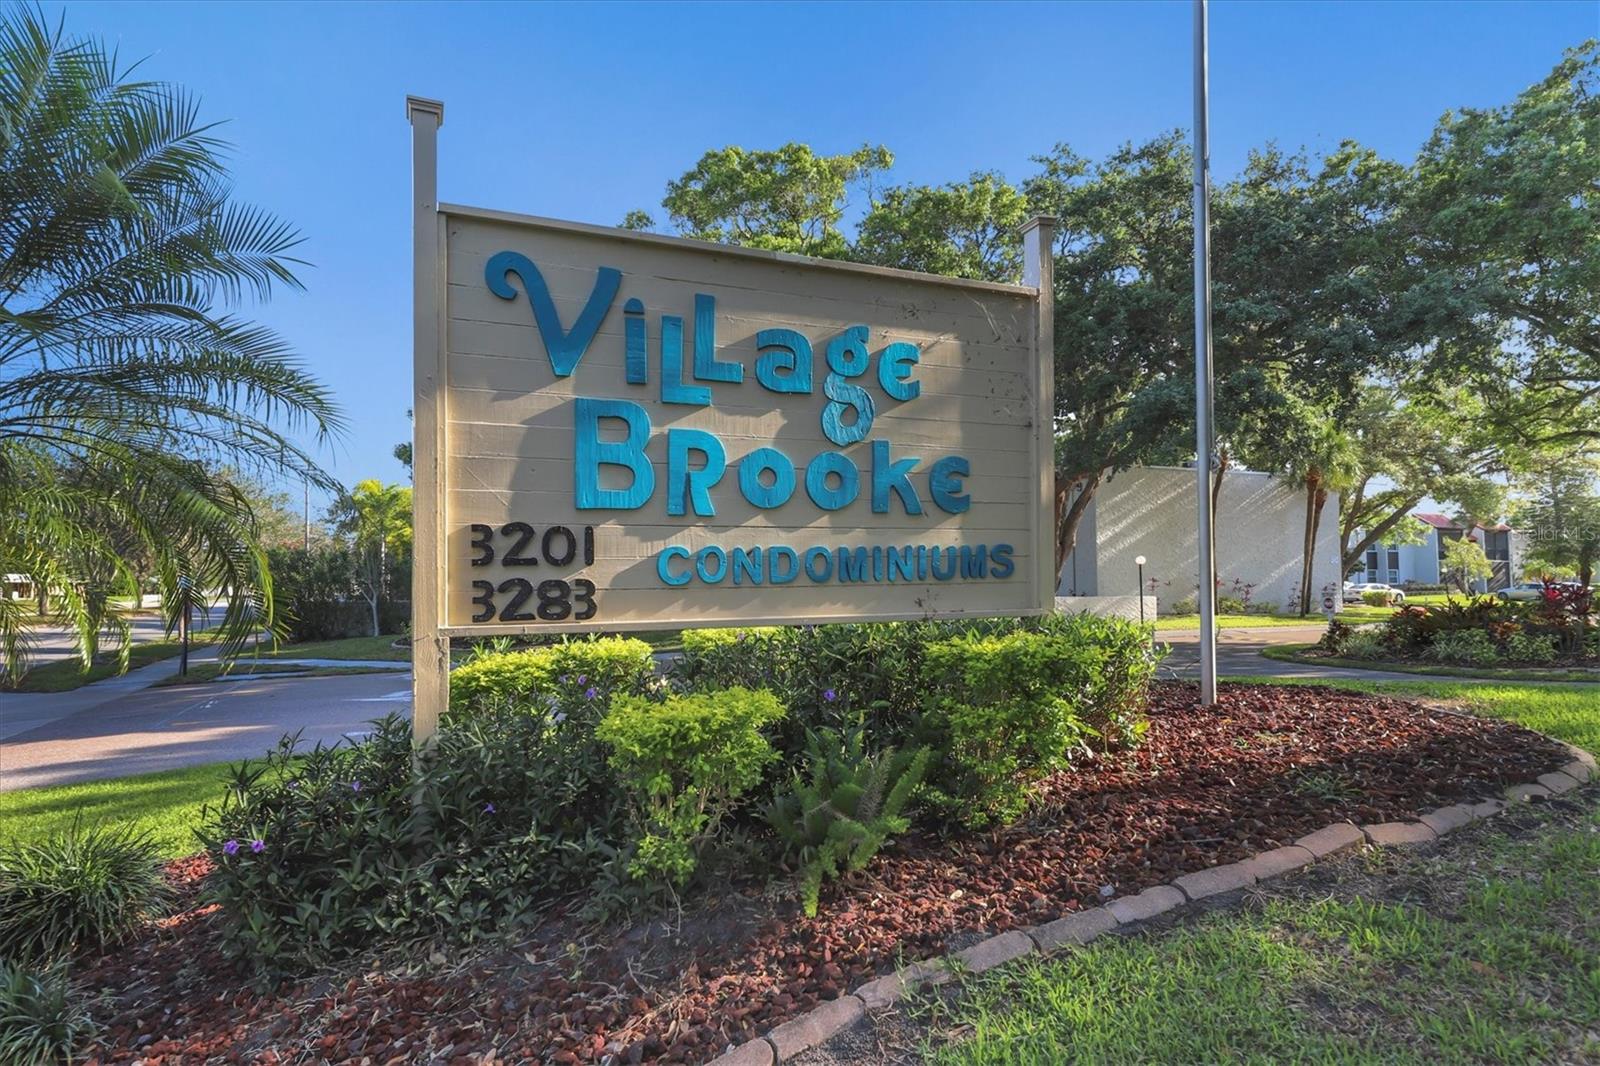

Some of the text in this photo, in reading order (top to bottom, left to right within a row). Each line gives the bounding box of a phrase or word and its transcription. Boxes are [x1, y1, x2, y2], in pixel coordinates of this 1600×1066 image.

[470, 521, 595, 567] 3201
[656, 543, 1015, 587] CONDOMINIUMS
[471, 577, 597, 623] 3283
